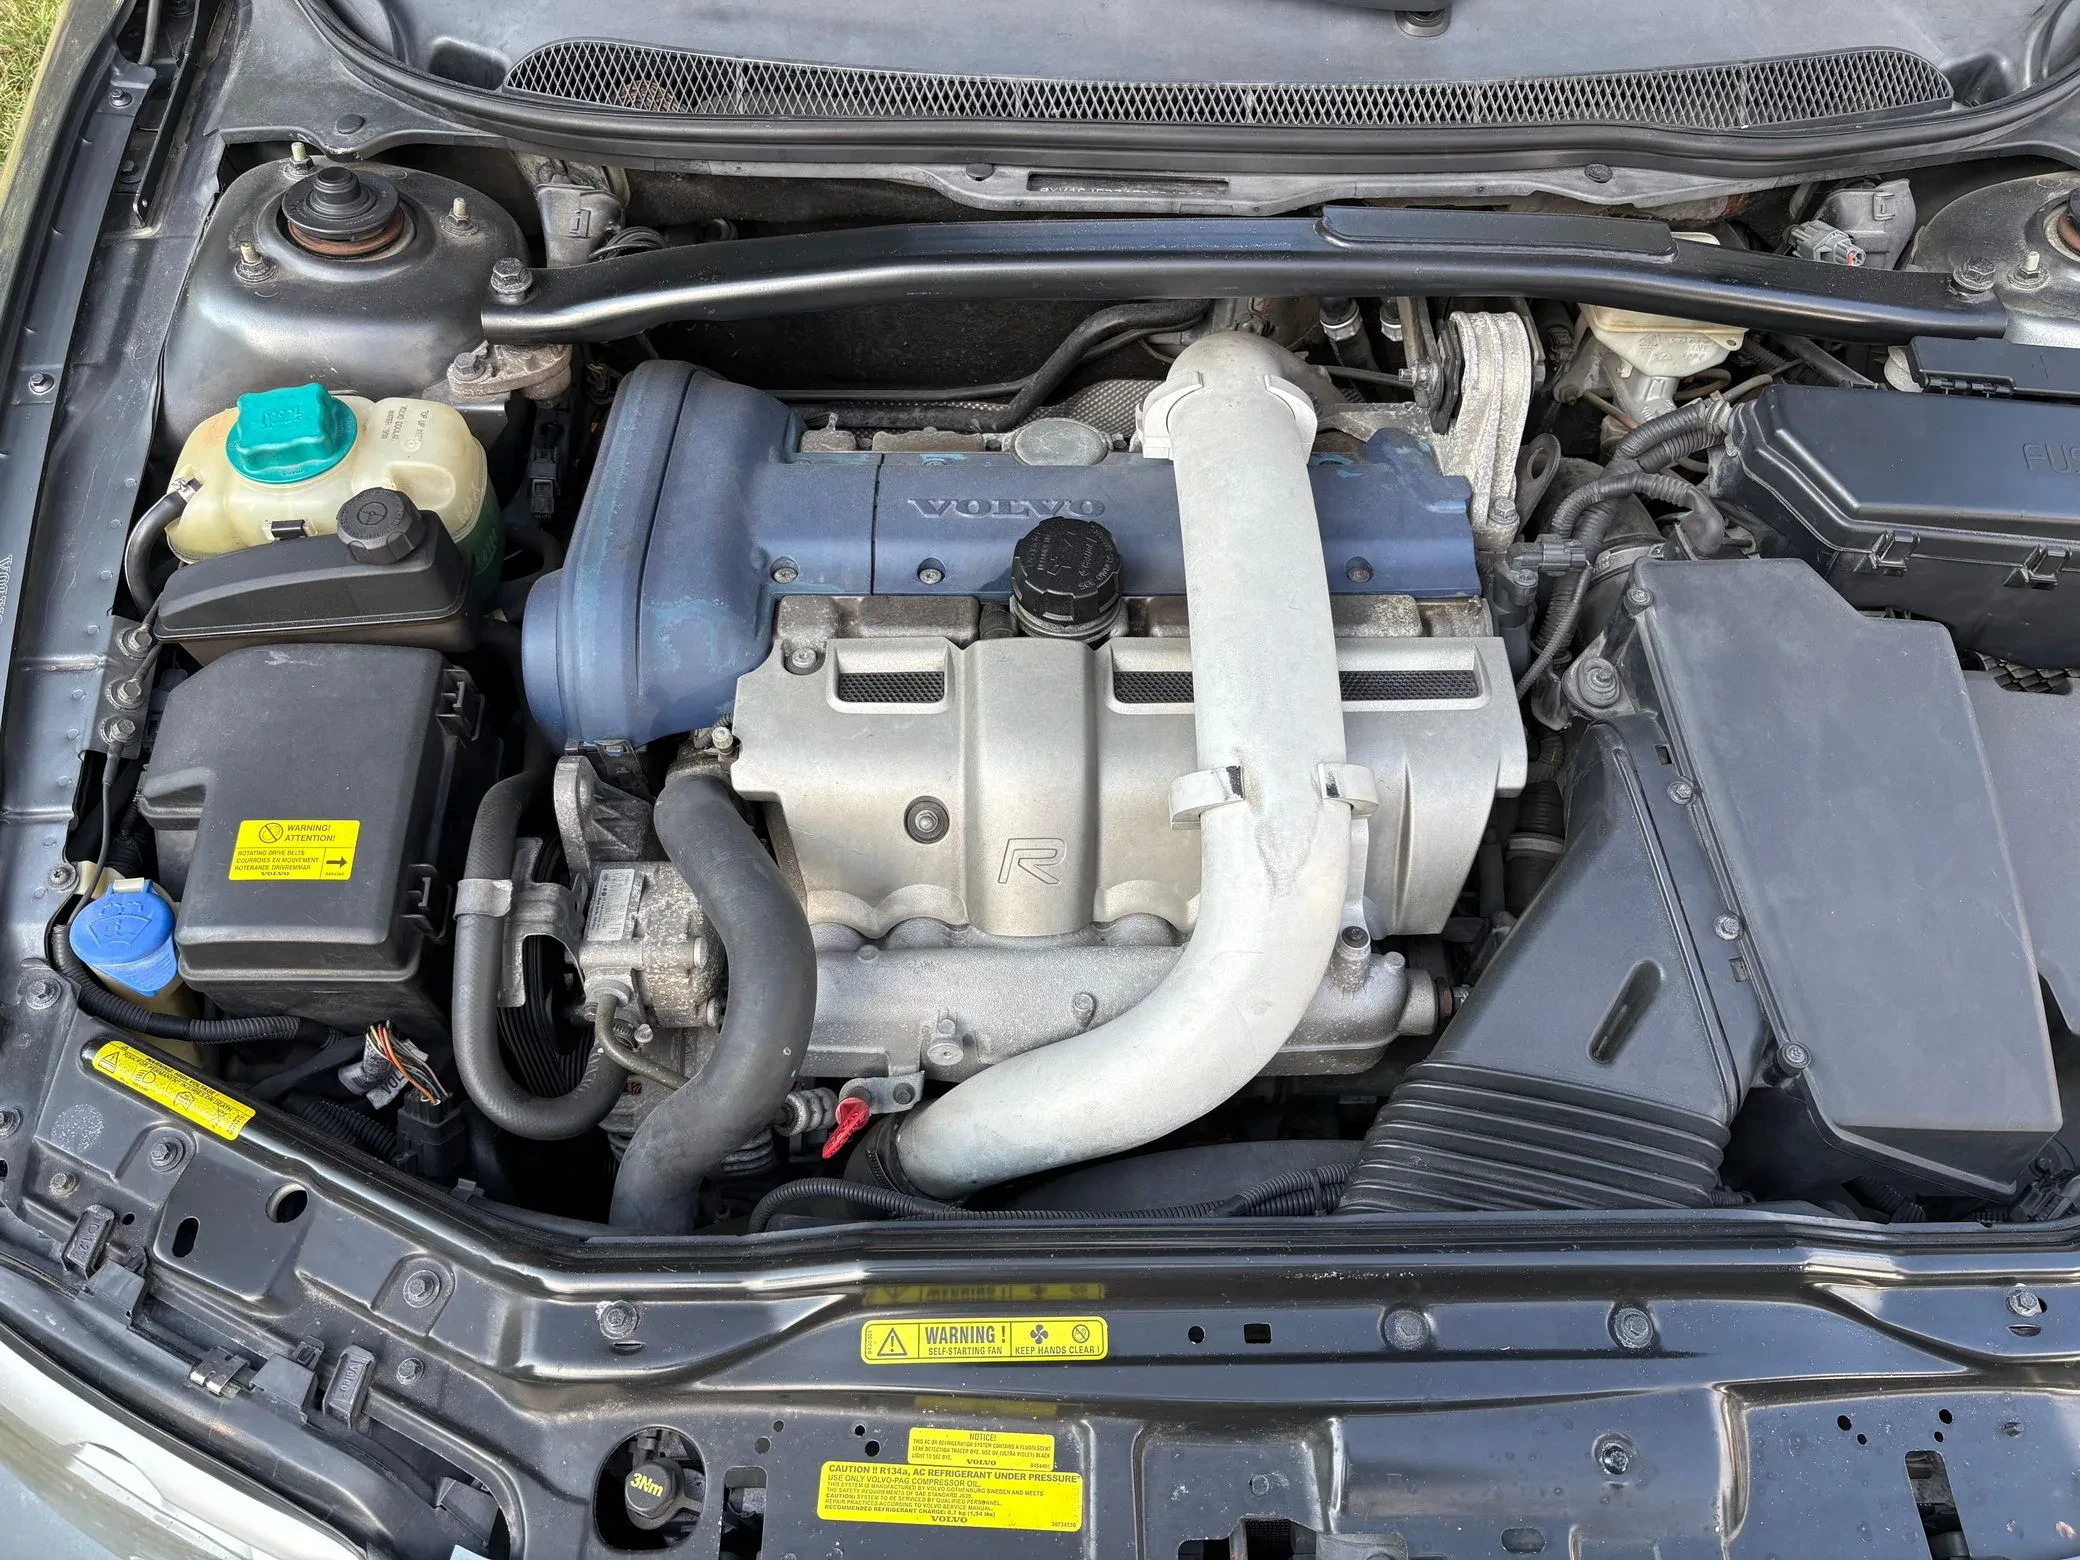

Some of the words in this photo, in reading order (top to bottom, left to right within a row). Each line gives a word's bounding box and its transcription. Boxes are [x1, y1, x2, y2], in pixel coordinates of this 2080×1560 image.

[907, 499, 1106, 518] VOLVO
[997, 838, 1067, 884] R
[925, 1326, 996, 1344] WARNING
[928, 1346, 985, 1356] SELF-STARTING
[988, 1346, 1002, 1354] FAN
[1015, 1346, 1036, 1354] KEEP
[1038, 1346, 1066, 1354] HANDS
[1068, 1346, 1095, 1354] CLEAR
[969, 1432, 997, 1442] NOTICE!
[828, 1464, 870, 1474] CAUTION
[872, 1466, 878, 1474] !!
[880, 1466, 910, 1476] R134a,
[912, 1468, 926, 1476] AC
[928, 1469, 992, 1479] REFRIGERANT
[994, 1471, 1026, 1480] UNDER
[630, 1472, 664, 1497] 3Nm
[866, 1476, 910, 1484] VOLVO-PAG
[912, 1478, 964, 1487] COMPRESSOR
[931, 1515, 968, 1524] VOLVO
